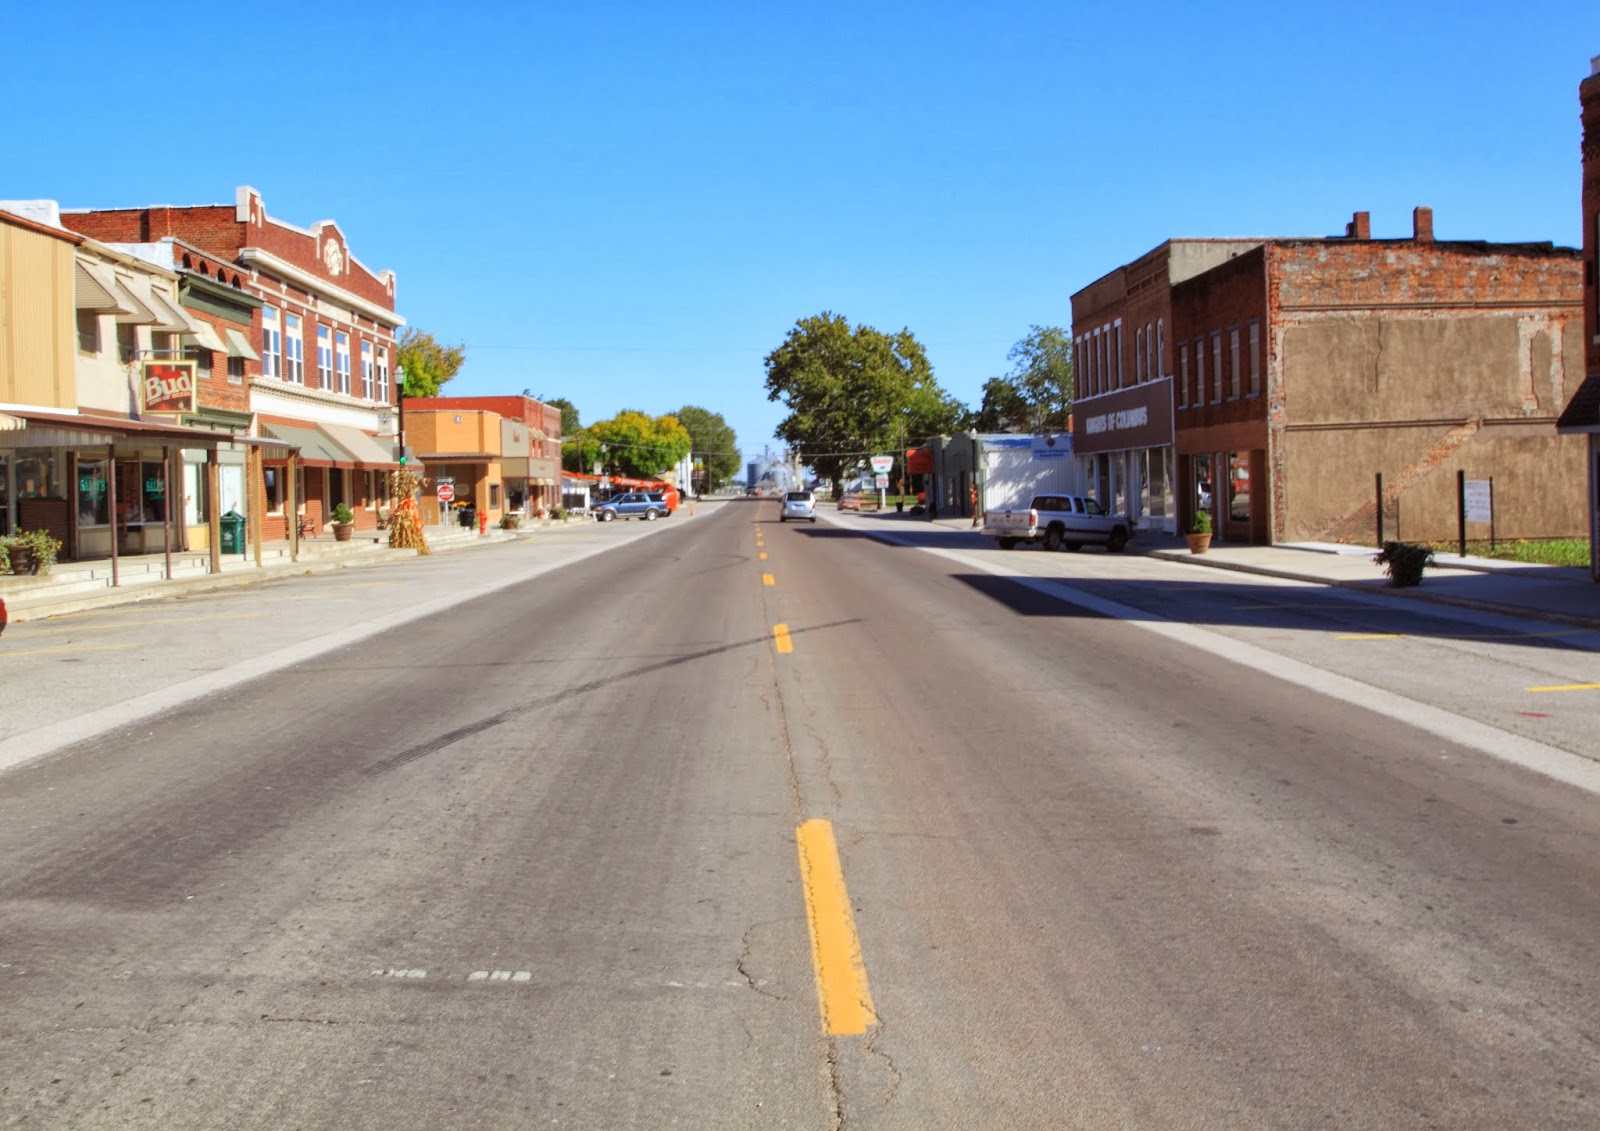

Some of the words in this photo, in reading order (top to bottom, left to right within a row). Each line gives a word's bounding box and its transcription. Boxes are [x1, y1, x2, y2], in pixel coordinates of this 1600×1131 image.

[145, 371, 192, 402] Bud
[1086, 414, 1107, 434] KNIGHTS
[1107, 412, 1116, 431] OF
[1116, 405, 1148, 429] COLUMBUS
